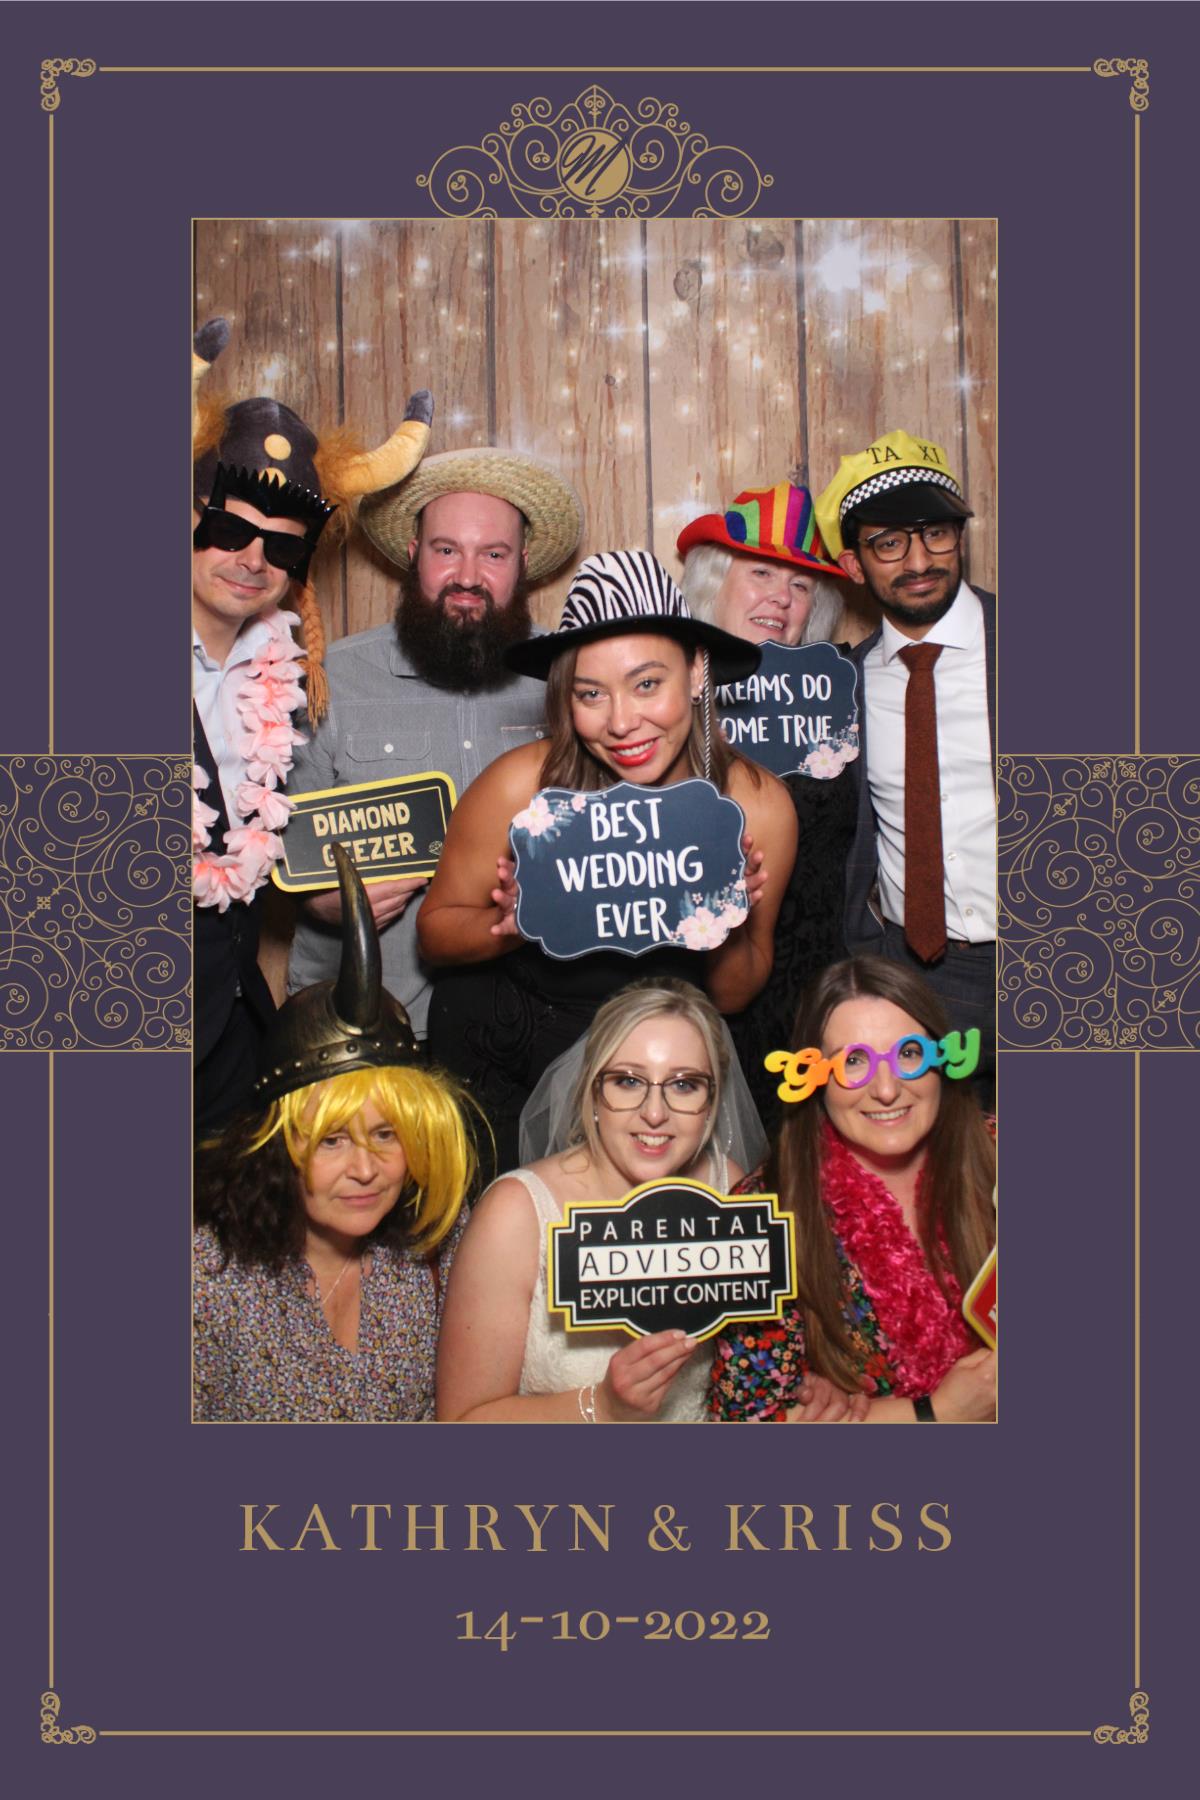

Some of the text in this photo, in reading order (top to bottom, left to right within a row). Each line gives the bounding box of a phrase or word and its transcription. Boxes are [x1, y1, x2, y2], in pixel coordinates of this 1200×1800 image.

[802, 674, 832, 701] DO
[715, 714, 833, 747] OME TRUE
[312, 802, 411, 838] DIAMOND
[590, 798, 663, 844] BEST
[556, 845, 704, 893] WEDDING
[595, 897, 671, 942] EVER
[579, 1214, 768, 1242] PARENTAL
[580, 1243, 769, 1277] ADVISORY
[579, 1279, 771, 1310] EXPLICIT CONTENT
